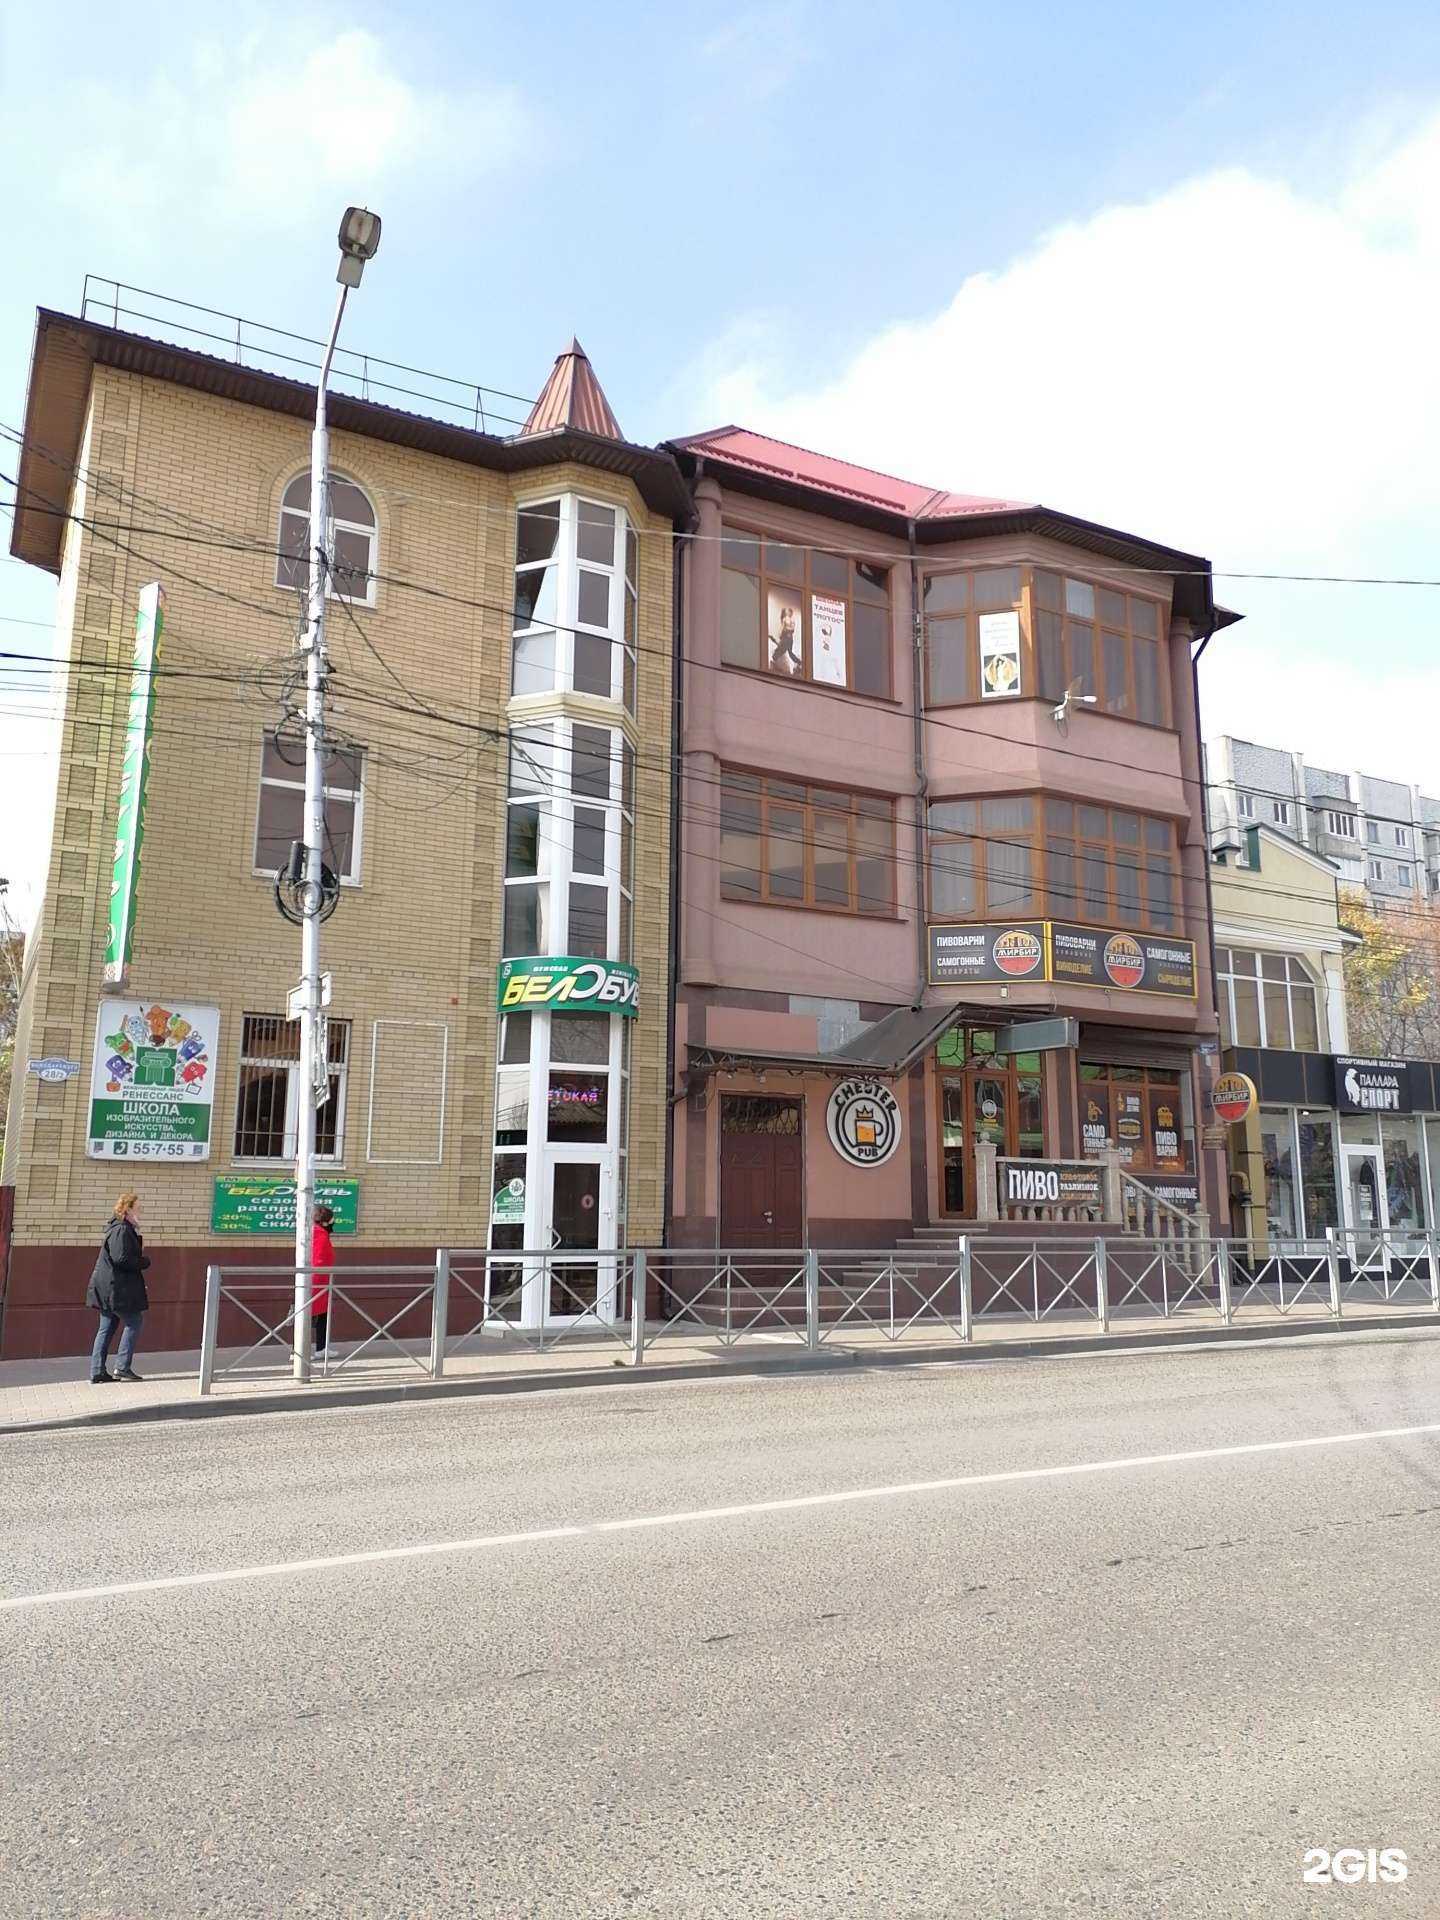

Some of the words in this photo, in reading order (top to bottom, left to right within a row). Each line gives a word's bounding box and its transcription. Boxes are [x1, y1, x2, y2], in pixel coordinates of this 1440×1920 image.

[814, 603, 843, 615] ТАНЦЕВ
[937, 935, 985, 947] ПИВОВАРНИ
[1055, 935, 1097, 951] ПИВОВАРНИ
[997, 948, 1037, 957] МИРБИР
[1146, 947, 1191, 963] САМОГОННЫЕ
[937, 956, 985, 967] САМОГОННЫЕ
[1108, 955, 1142, 968] МИРБИР
[502, 963, 640, 1007] БЕЛОБУВ
[1337, 1057, 1378, 1067] СПОРТИВНЫЙ
[1378, 1060, 1407, 1069] МАГАЗИН
[122, 1090, 184, 1101] РЕНЕССАНС
[547, 1090, 598, 1102] ЕТСКАЯ
[1215, 1092, 1249, 1103] МИРБИР
[1361, 1087, 1400, 1110] СПОРТ
[123, 1101, 180, 1116] ШКОЛА
[106, 1113, 196, 1125] ИЗОБРАЗИТЕЛЬНОГО
[124, 1122, 176, 1132] ИСКУССТВА,
[1083, 1124, 1106, 1138] САМО
[105, 1129, 147, 1139] ДИЗАЙНА
[159, 1132, 194, 1140] ДЕКОРА
[1155, 1131, 1178, 1145] ПИВО
[857, 1147, 878, 1157] PUB
[224, 1176, 348, 1184] МАГАИН
[1008, 1169, 1059, 1201] ПИВО
[227, 1186, 352, 1196] БЕЛОВЬ
[1154, 1186, 1198, 1199] САМОГОННЫЕ
[251, 1197, 333, 1205] сезоая
[237, 1204, 343, 1214] распроа
[264, 1213, 297, 1221] обу
